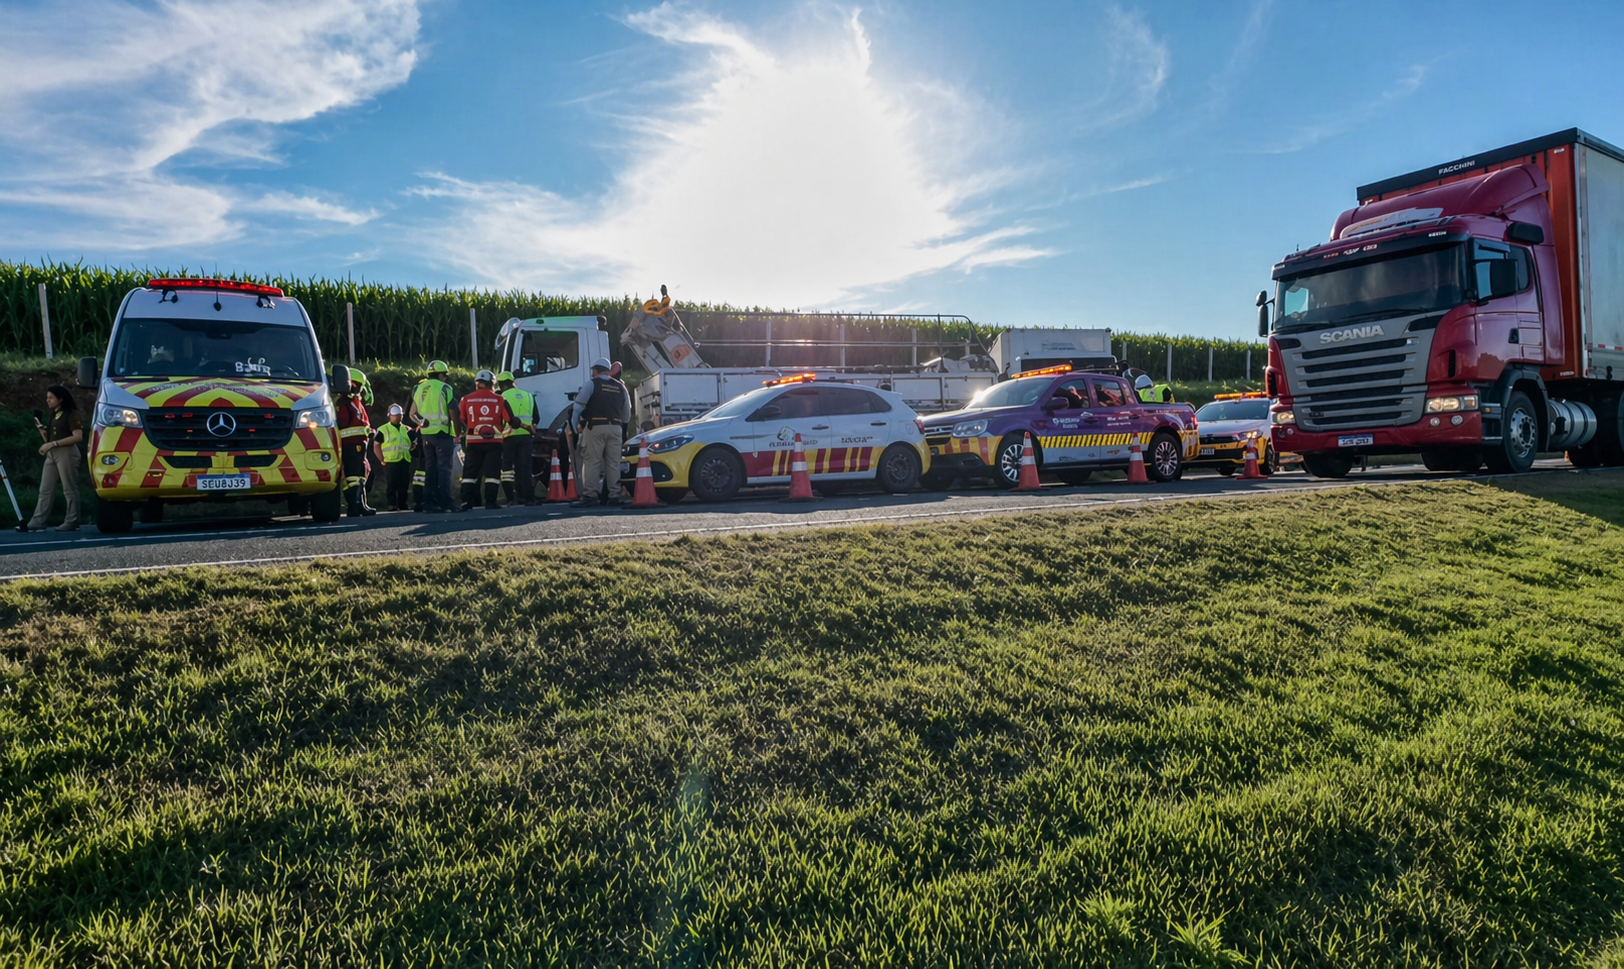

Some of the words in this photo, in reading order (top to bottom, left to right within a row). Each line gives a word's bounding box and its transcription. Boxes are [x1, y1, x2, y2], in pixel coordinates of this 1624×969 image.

[1438, 160, 1475, 175] FACCHINI
[1319, 324, 1385, 345] SCANIA
[202, 478, 246, 489] SEU8J39
